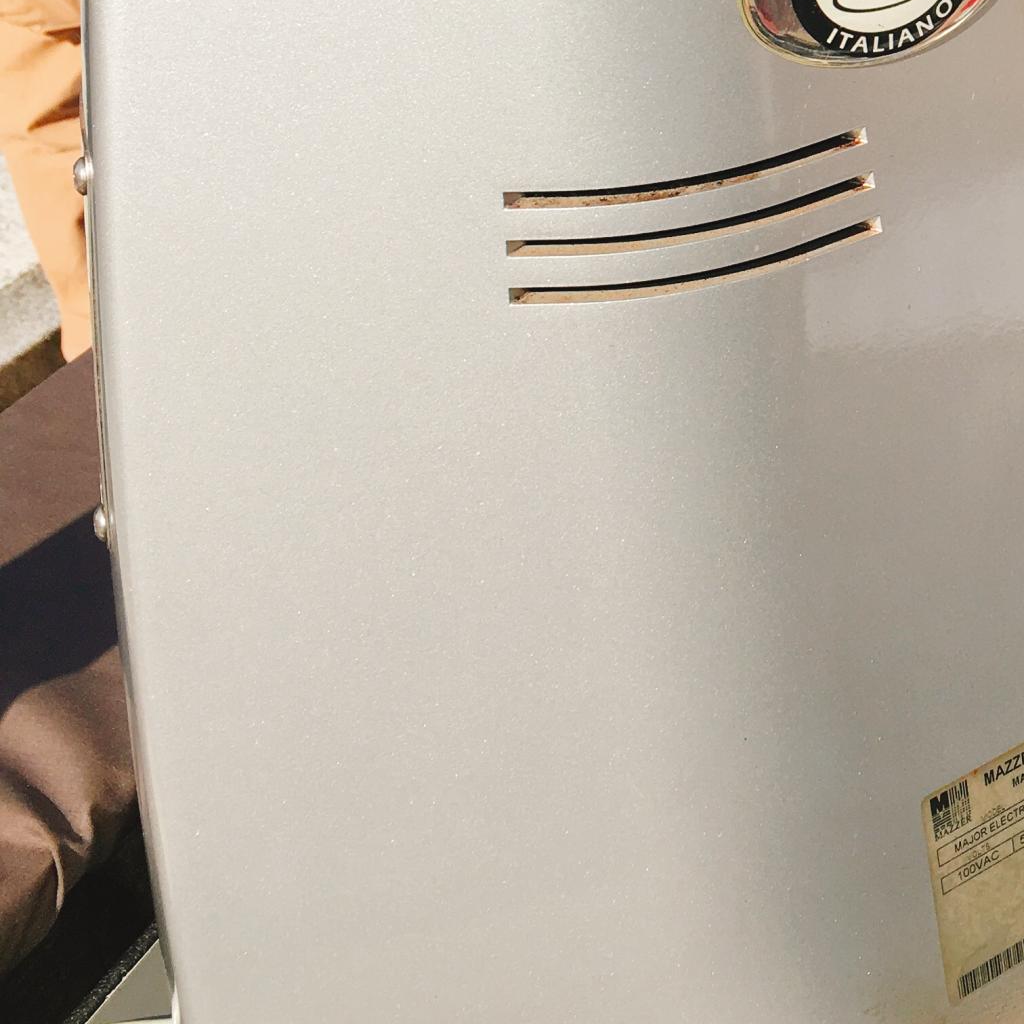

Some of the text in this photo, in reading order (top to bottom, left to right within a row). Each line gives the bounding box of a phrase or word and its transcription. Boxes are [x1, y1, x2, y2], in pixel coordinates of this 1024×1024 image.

[934, 813, 972, 841] MAZZER
[953, 825, 987, 853] MAJOR
[957, 848, 999, 881] 100VAC
